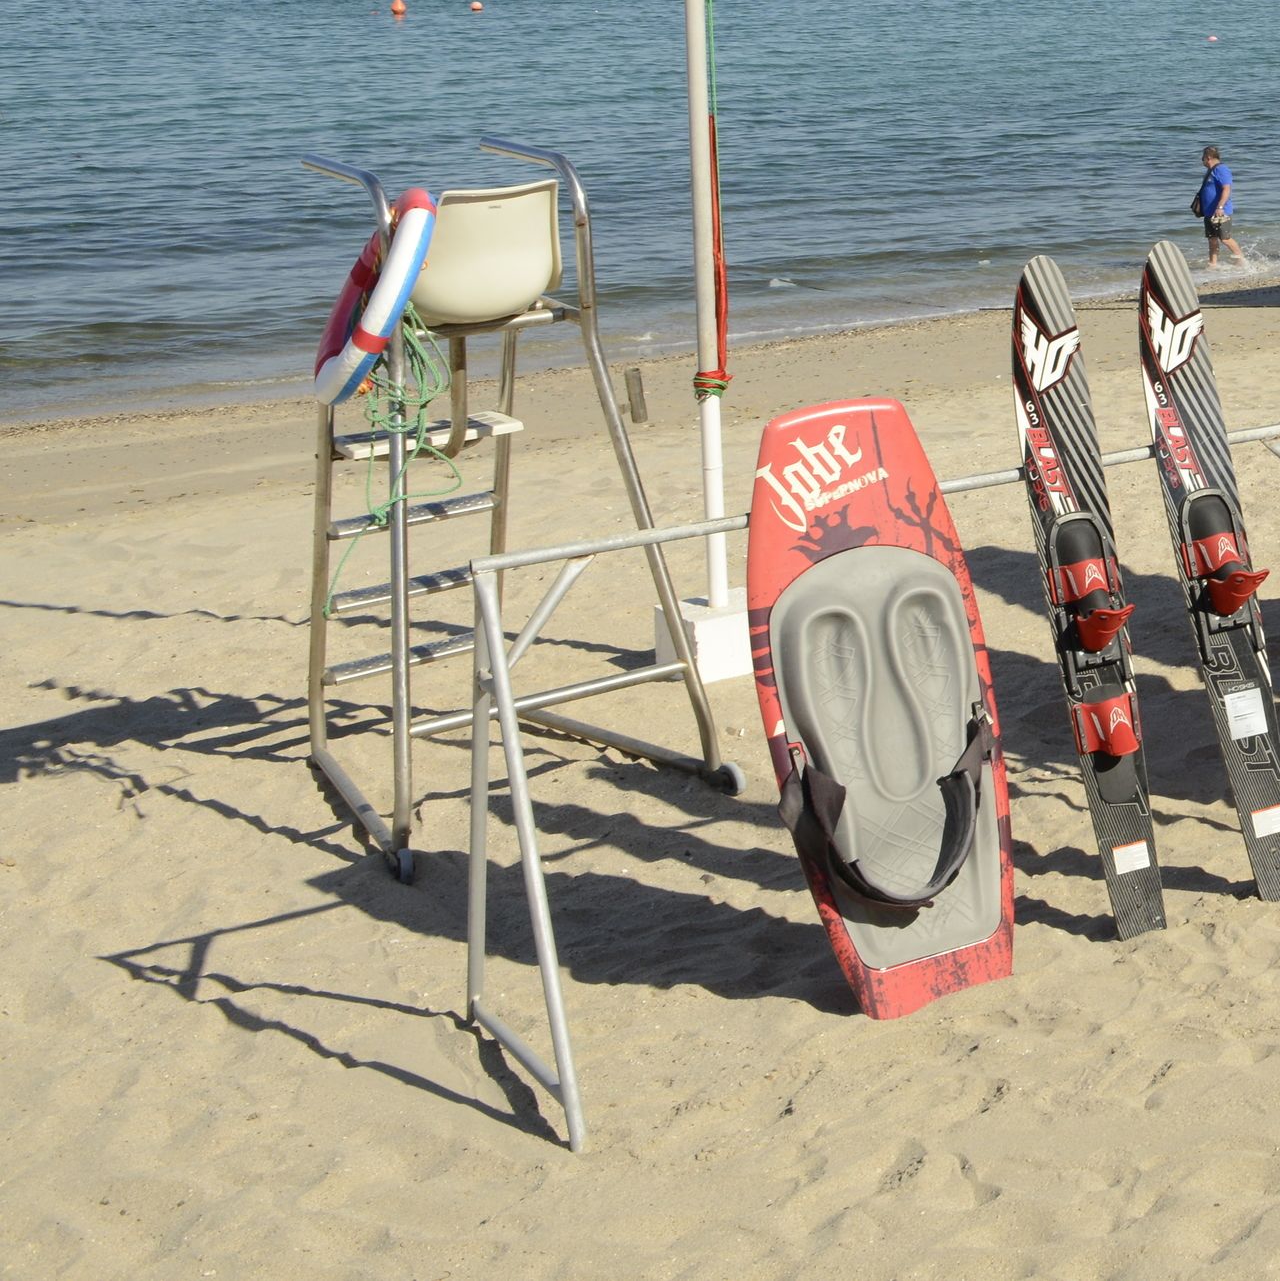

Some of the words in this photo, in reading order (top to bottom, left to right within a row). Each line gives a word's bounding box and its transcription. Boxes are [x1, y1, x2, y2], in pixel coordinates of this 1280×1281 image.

[1020, 307, 1081, 392] HO
[1146, 291, 1203, 374] HO
[755, 425, 862, 533] Jobe
[1027, 427, 1068, 493] BLAST
[1156, 408, 1199, 471] BLAST
